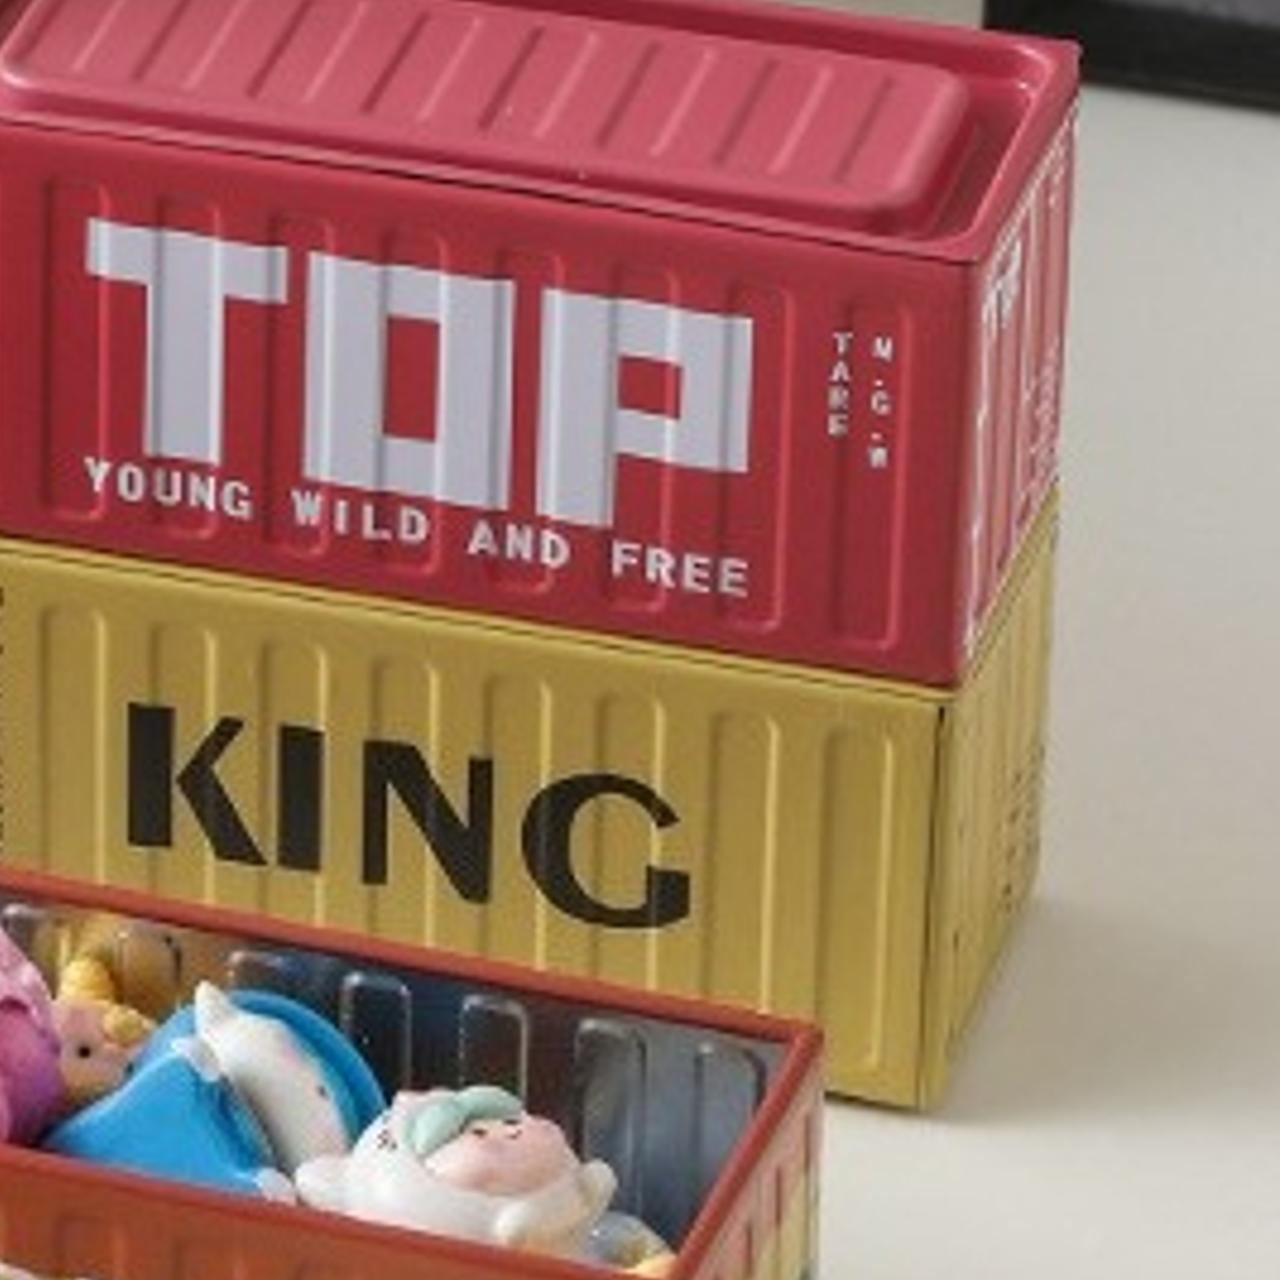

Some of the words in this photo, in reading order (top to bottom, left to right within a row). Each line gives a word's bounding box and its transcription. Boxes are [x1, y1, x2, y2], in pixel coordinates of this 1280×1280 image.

[86, 216, 754, 528] TOP
[84, 457, 252, 521] YOUNG
[293, 490, 430, 545] WILD
[469, 520, 570, 571] AND
[613, 546, 748, 598] FREE
[126, 700, 692, 930] KING
